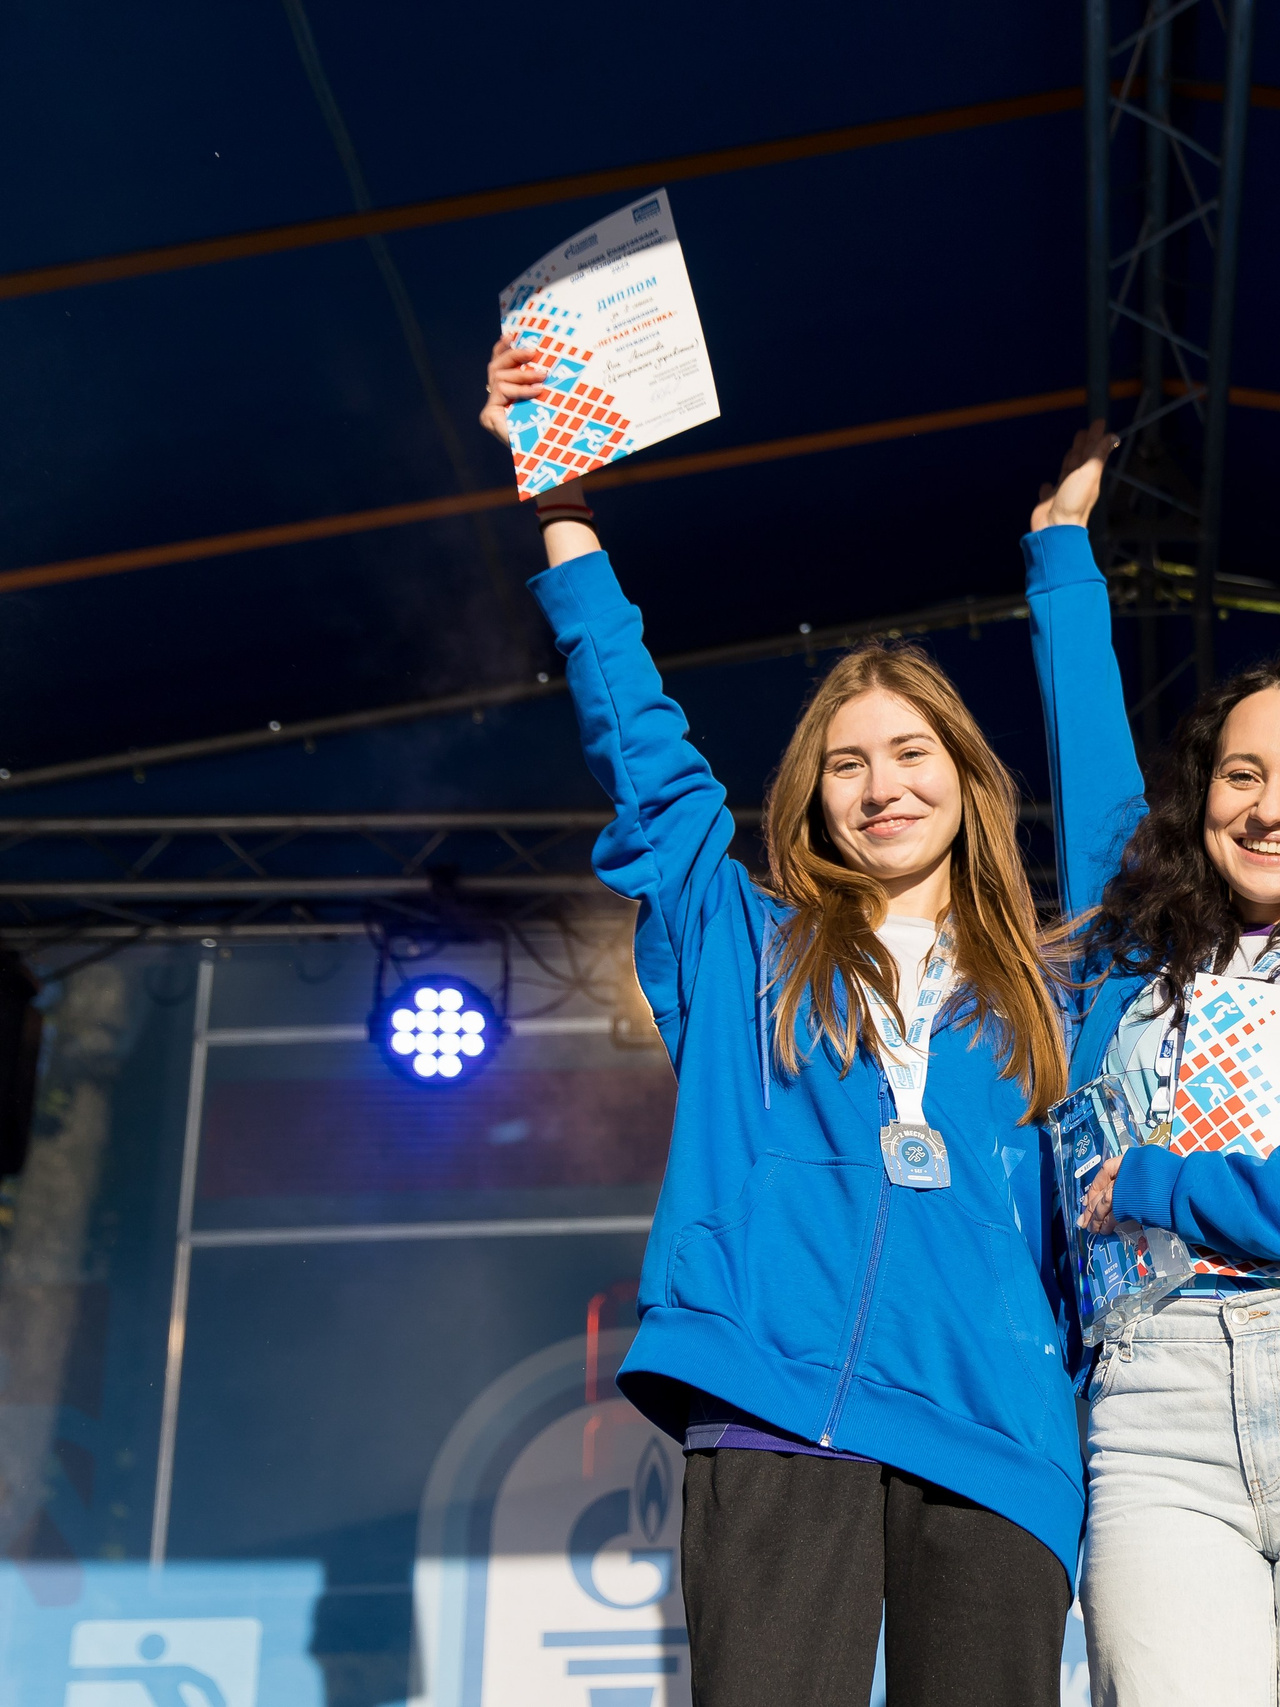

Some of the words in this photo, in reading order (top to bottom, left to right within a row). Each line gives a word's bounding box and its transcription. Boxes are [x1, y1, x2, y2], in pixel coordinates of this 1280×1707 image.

[597, 276, 658, 312] ДИПЛОМ
[903, 1130, 925, 1140] МЕСТО
[1099, 1238, 1112, 1265] 1
